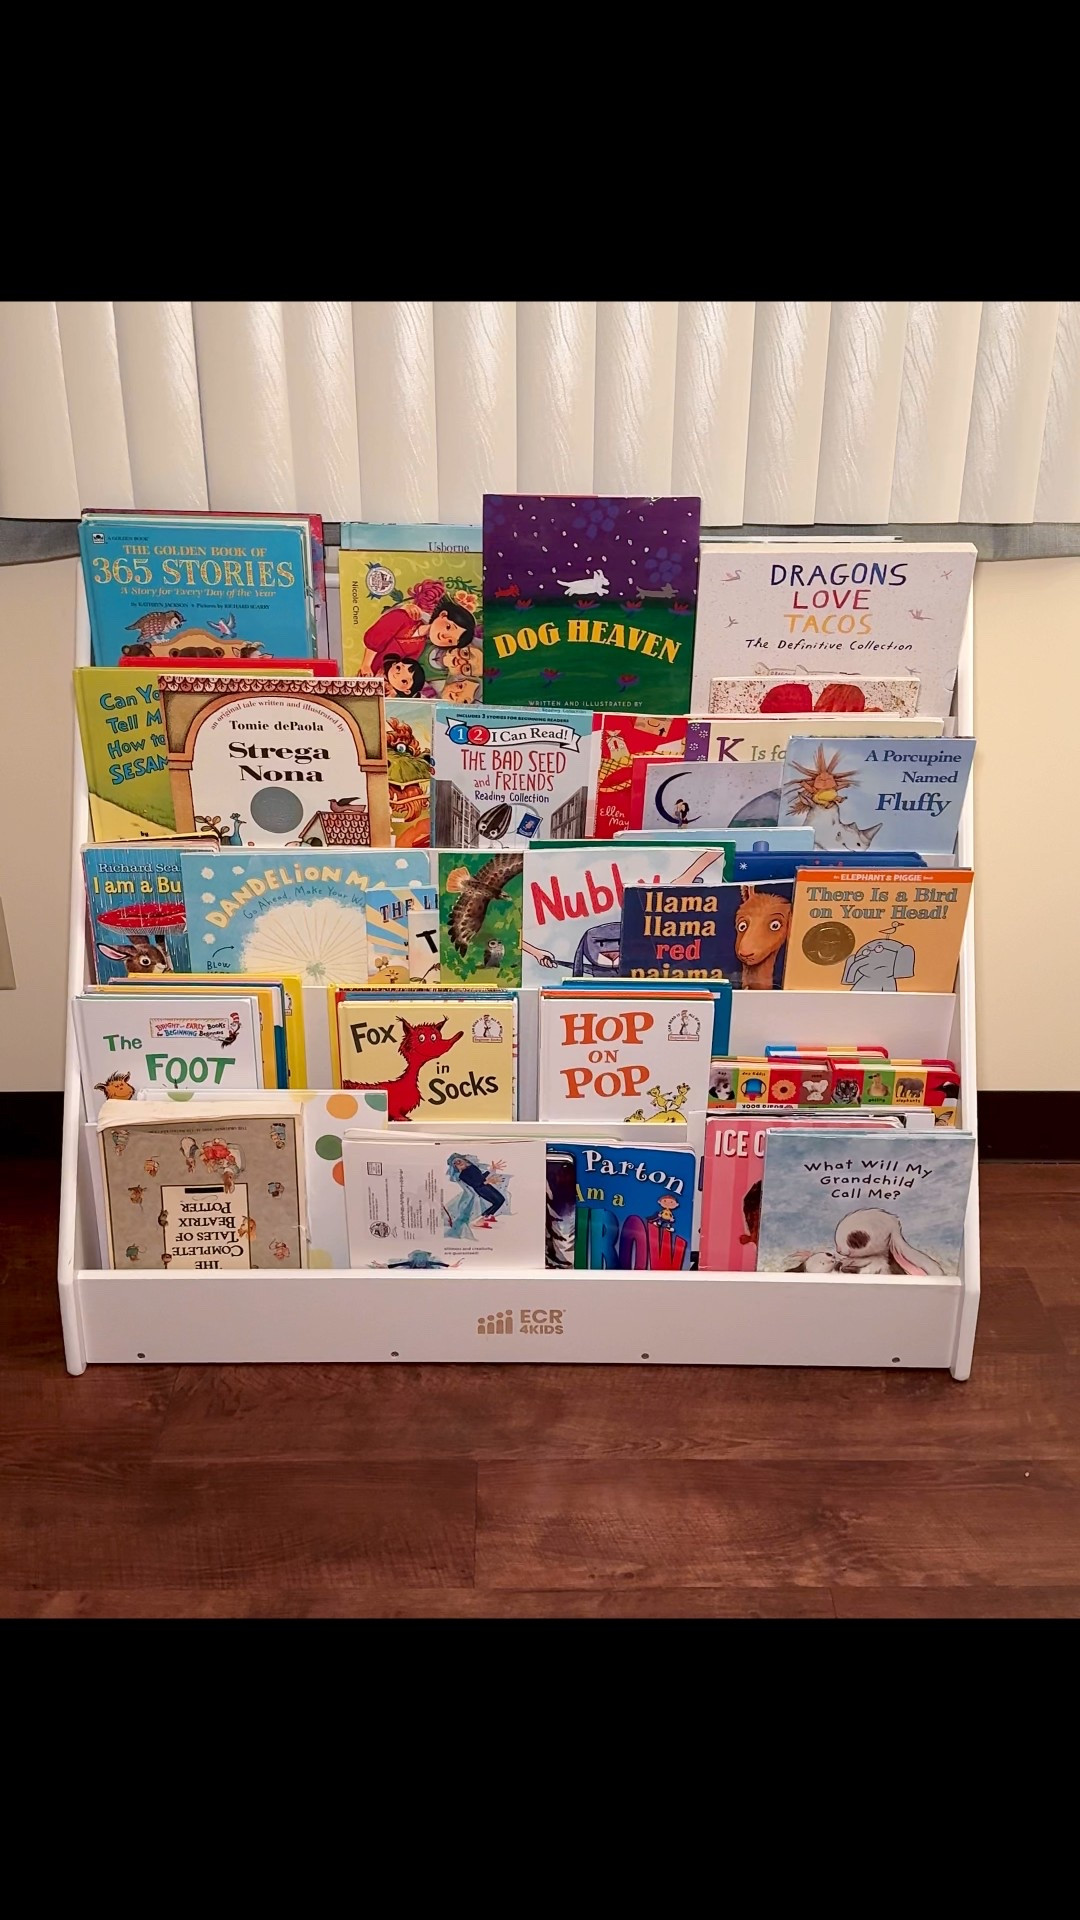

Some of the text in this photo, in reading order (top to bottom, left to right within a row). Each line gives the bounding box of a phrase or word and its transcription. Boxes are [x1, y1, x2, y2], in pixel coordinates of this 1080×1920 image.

[123, 545, 268, 558] THE GOLDEN BOOK OF
[428, 541, 470, 552] Usborne
[92, 558, 295, 588] 365 STORIES
[771, 563, 908, 586] DRAGONS
[132, 586, 158, 597] Story
[156, 588, 172, 597] for
[174, 588, 202, 598] Every
[204, 588, 224, 598] Day
[226, 588, 237, 598] of
[237, 589, 252, 598] the
[254, 590, 276, 598] Year
[793, 590, 872, 610] LOVE
[784, 614, 873, 635] TACOS
[493, 619, 682, 664] DOG HEAVEN
[746, 638, 913, 651] The Definitive Collection
[100, 693, 138, 710] Can
[106, 714, 139, 734] Tell
[211, 699, 346, 734] an original tale written and illustrated by
[229, 720, 324, 732] Tomie dePaola
[458, 727, 568, 743] 1 2 I Can Read!
[107, 739, 146, 760] How
[228, 741, 331, 764] Strega
[716, 736, 745, 762] K
[751, 745, 766, 760] Is
[460, 748, 566, 774] THE BAD SEED
[864, 750, 962, 766] A Porcupine
[238, 765, 325, 782] Nona
[474, 772, 554, 792] and FRIENDS
[901, 770, 958, 784] Named
[474, 790, 550, 803] Reading Collection
[875, 792, 952, 818] Fluffy
[600, 805, 626, 818] Ellen
[608, 818, 630, 831] May
[98, 863, 153, 873] Richard
[93, 876, 182, 894] I am a Bu
[243, 908, 258, 920] Go
[294, 886, 323, 898] Make
[328, 885, 348, 900] Your
[644, 891, 718, 913] llama
[806, 886, 959, 902] There Is a Bird
[810, 904, 949, 920] on Your Head!
[643, 916, 716, 937] llama
[656, 939, 701, 961] red
[155, 1022, 181, 1032] BRIGHT
[186, 1022, 206, 1031] EARLY
[560, 1011, 654, 1046] HOP
[103, 1034, 143, 1052] The
[588, 1050, 620, 1064] ON
[145, 1054, 236, 1085] FOOT
[436, 1062, 450, 1074] in
[428, 1071, 499, 1106] Socks
[560, 1065, 650, 1099] POP
[714, 1130, 749, 1158] ICE
[582, 1150, 685, 1196] Parton
[804, 1159, 933, 1179] What Will My
[820, 1174, 915, 1189] Grandchild
[612, 1192, 625, 1208] a
[830, 1188, 901, 1200] Call Me?
[180, 1202, 232, 1214] POTTER
[178, 1216, 236, 1228] BEATRIX
[175, 1231, 240, 1244] TALES OF
[172, 1244, 244, 1257] COMPLETE
[196, 1260, 224, 1270] THE
[520, 1309, 563, 1324] ECR
[520, 1325, 564, 1335] 4KIDS
